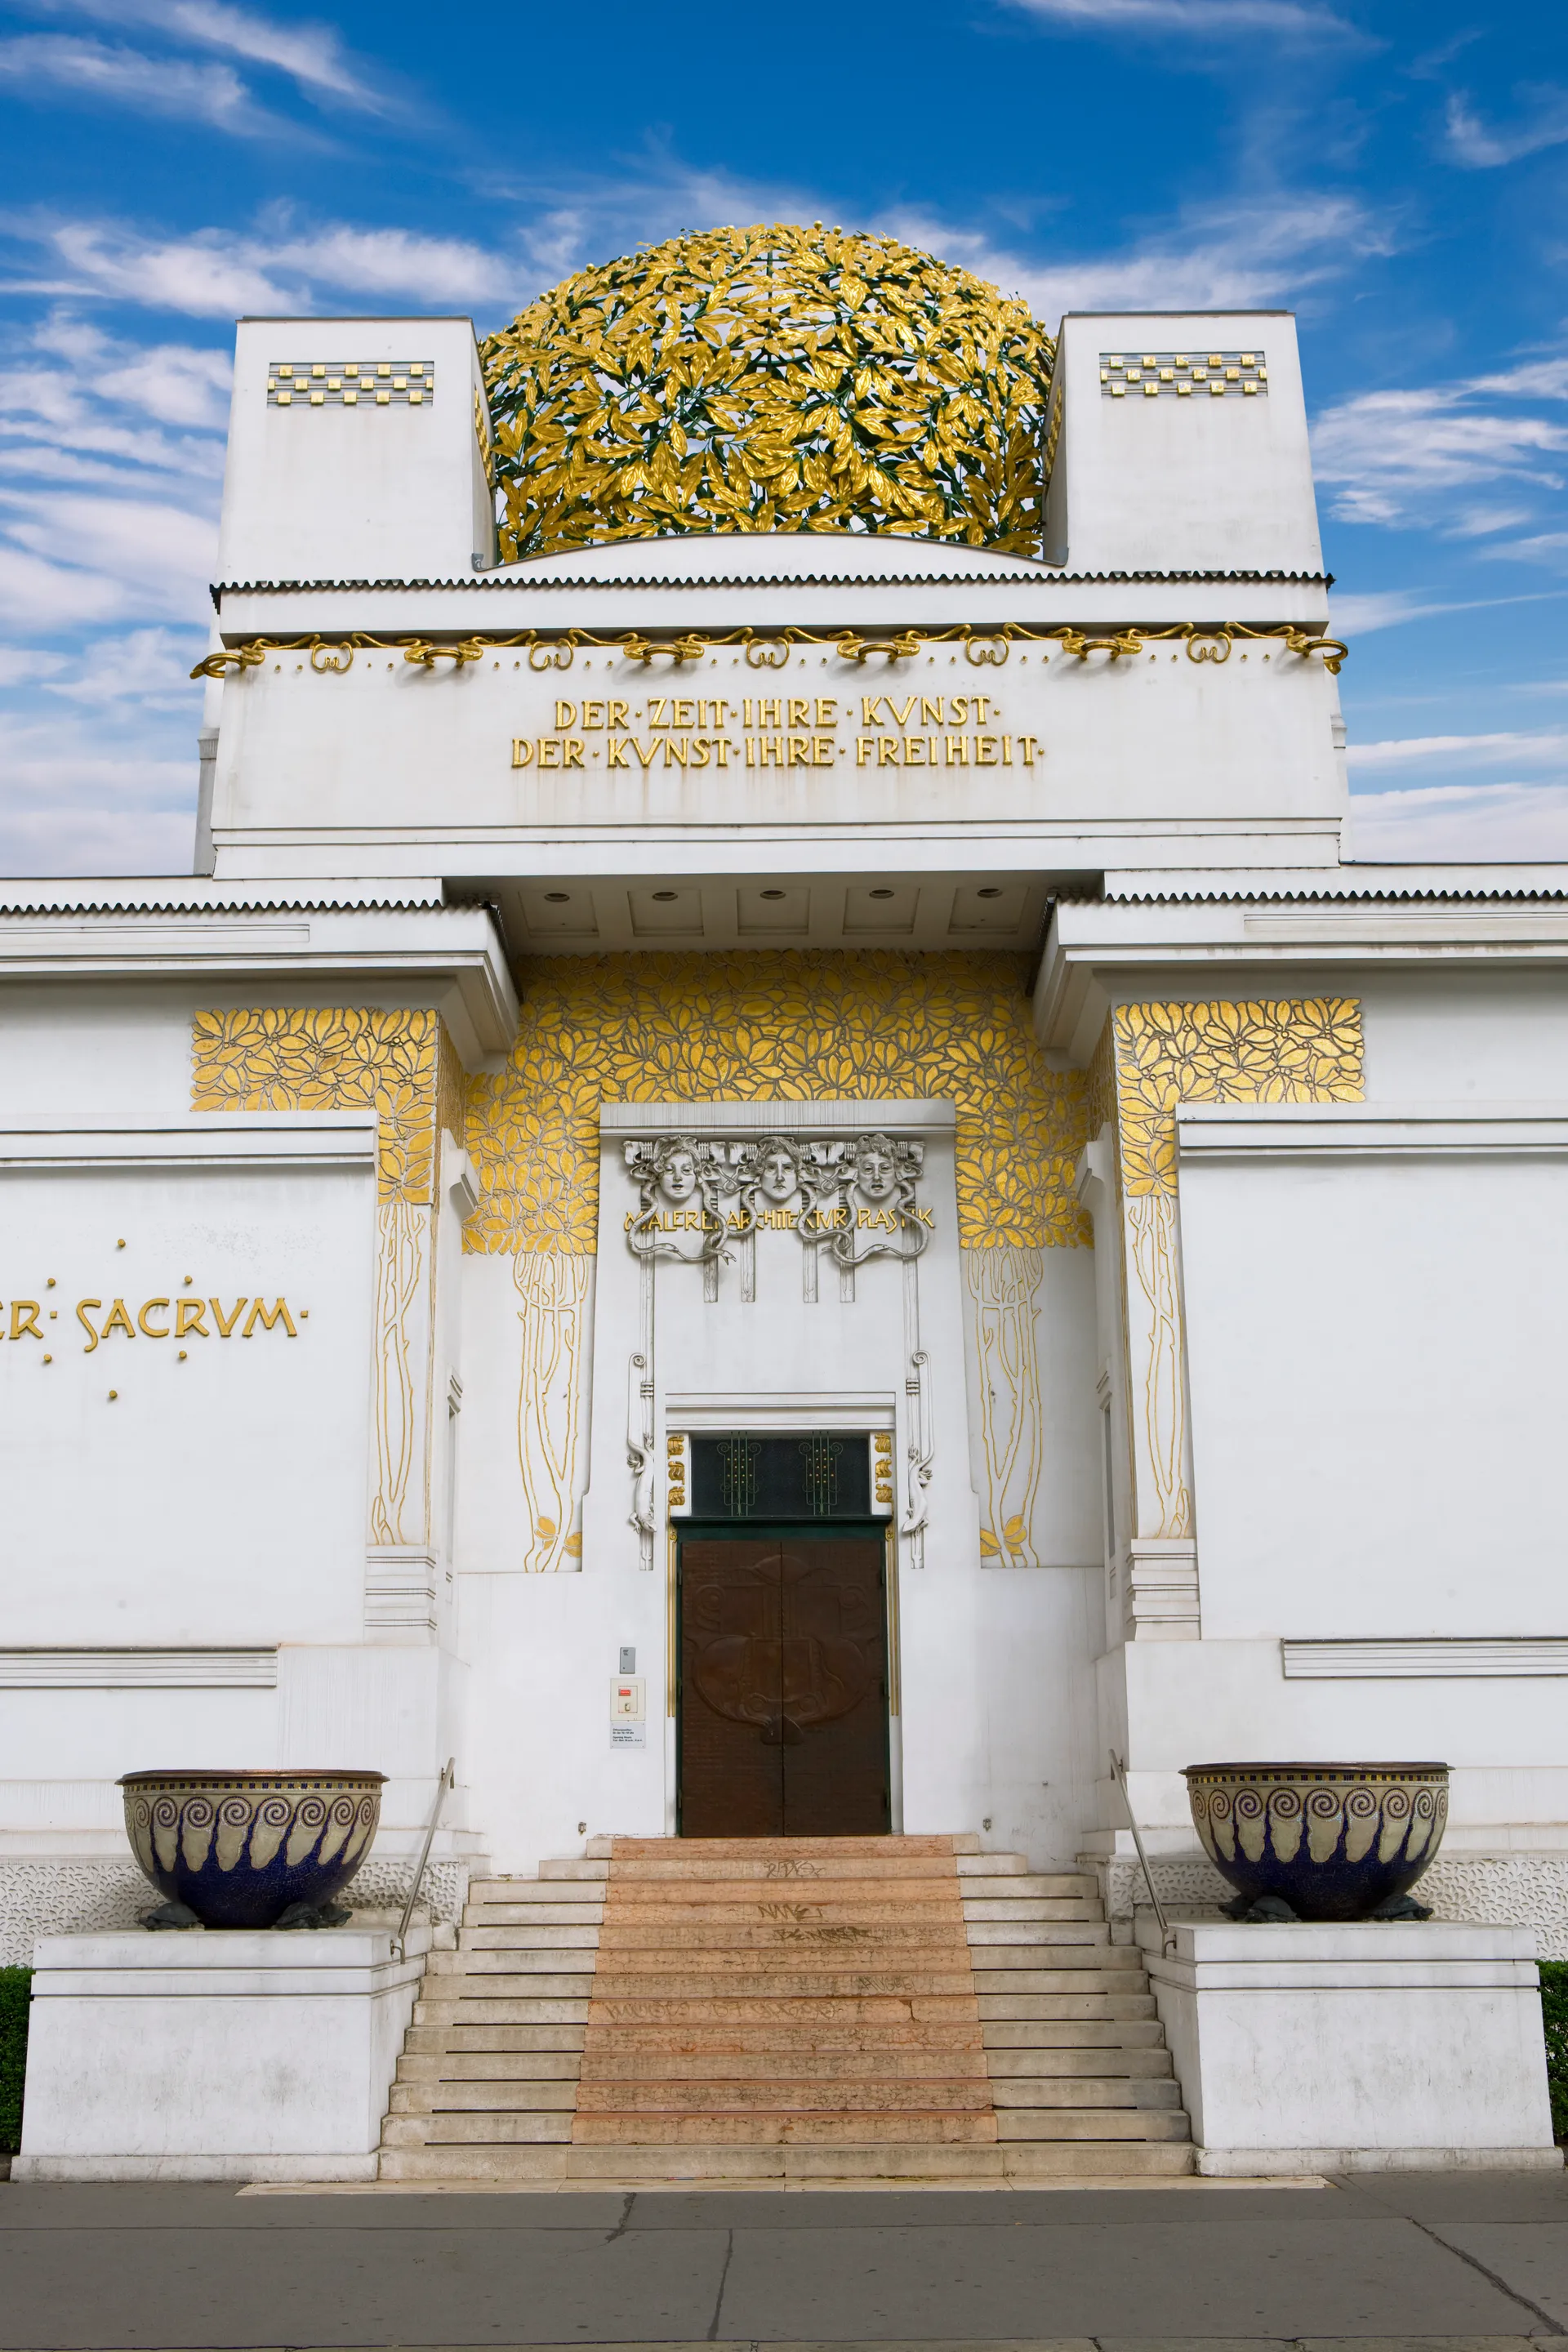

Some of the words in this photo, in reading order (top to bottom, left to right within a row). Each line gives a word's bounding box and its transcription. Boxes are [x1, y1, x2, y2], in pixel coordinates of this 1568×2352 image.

[555, 700, 630, 730] DER
[648, 699, 729, 729] ZEIT
[742, 698, 838, 728] IHRE
[862, 697, 991, 728] KVNST
[512, 738, 586, 768] DER
[608, 737, 733, 769] KVNST
[746, 737, 835, 768] IHRE
[856, 736, 1038, 768] FREIHEIT
[858, 1208, 935, 1234] PLASK
[76, 1298, 297, 1352] SACRVM
